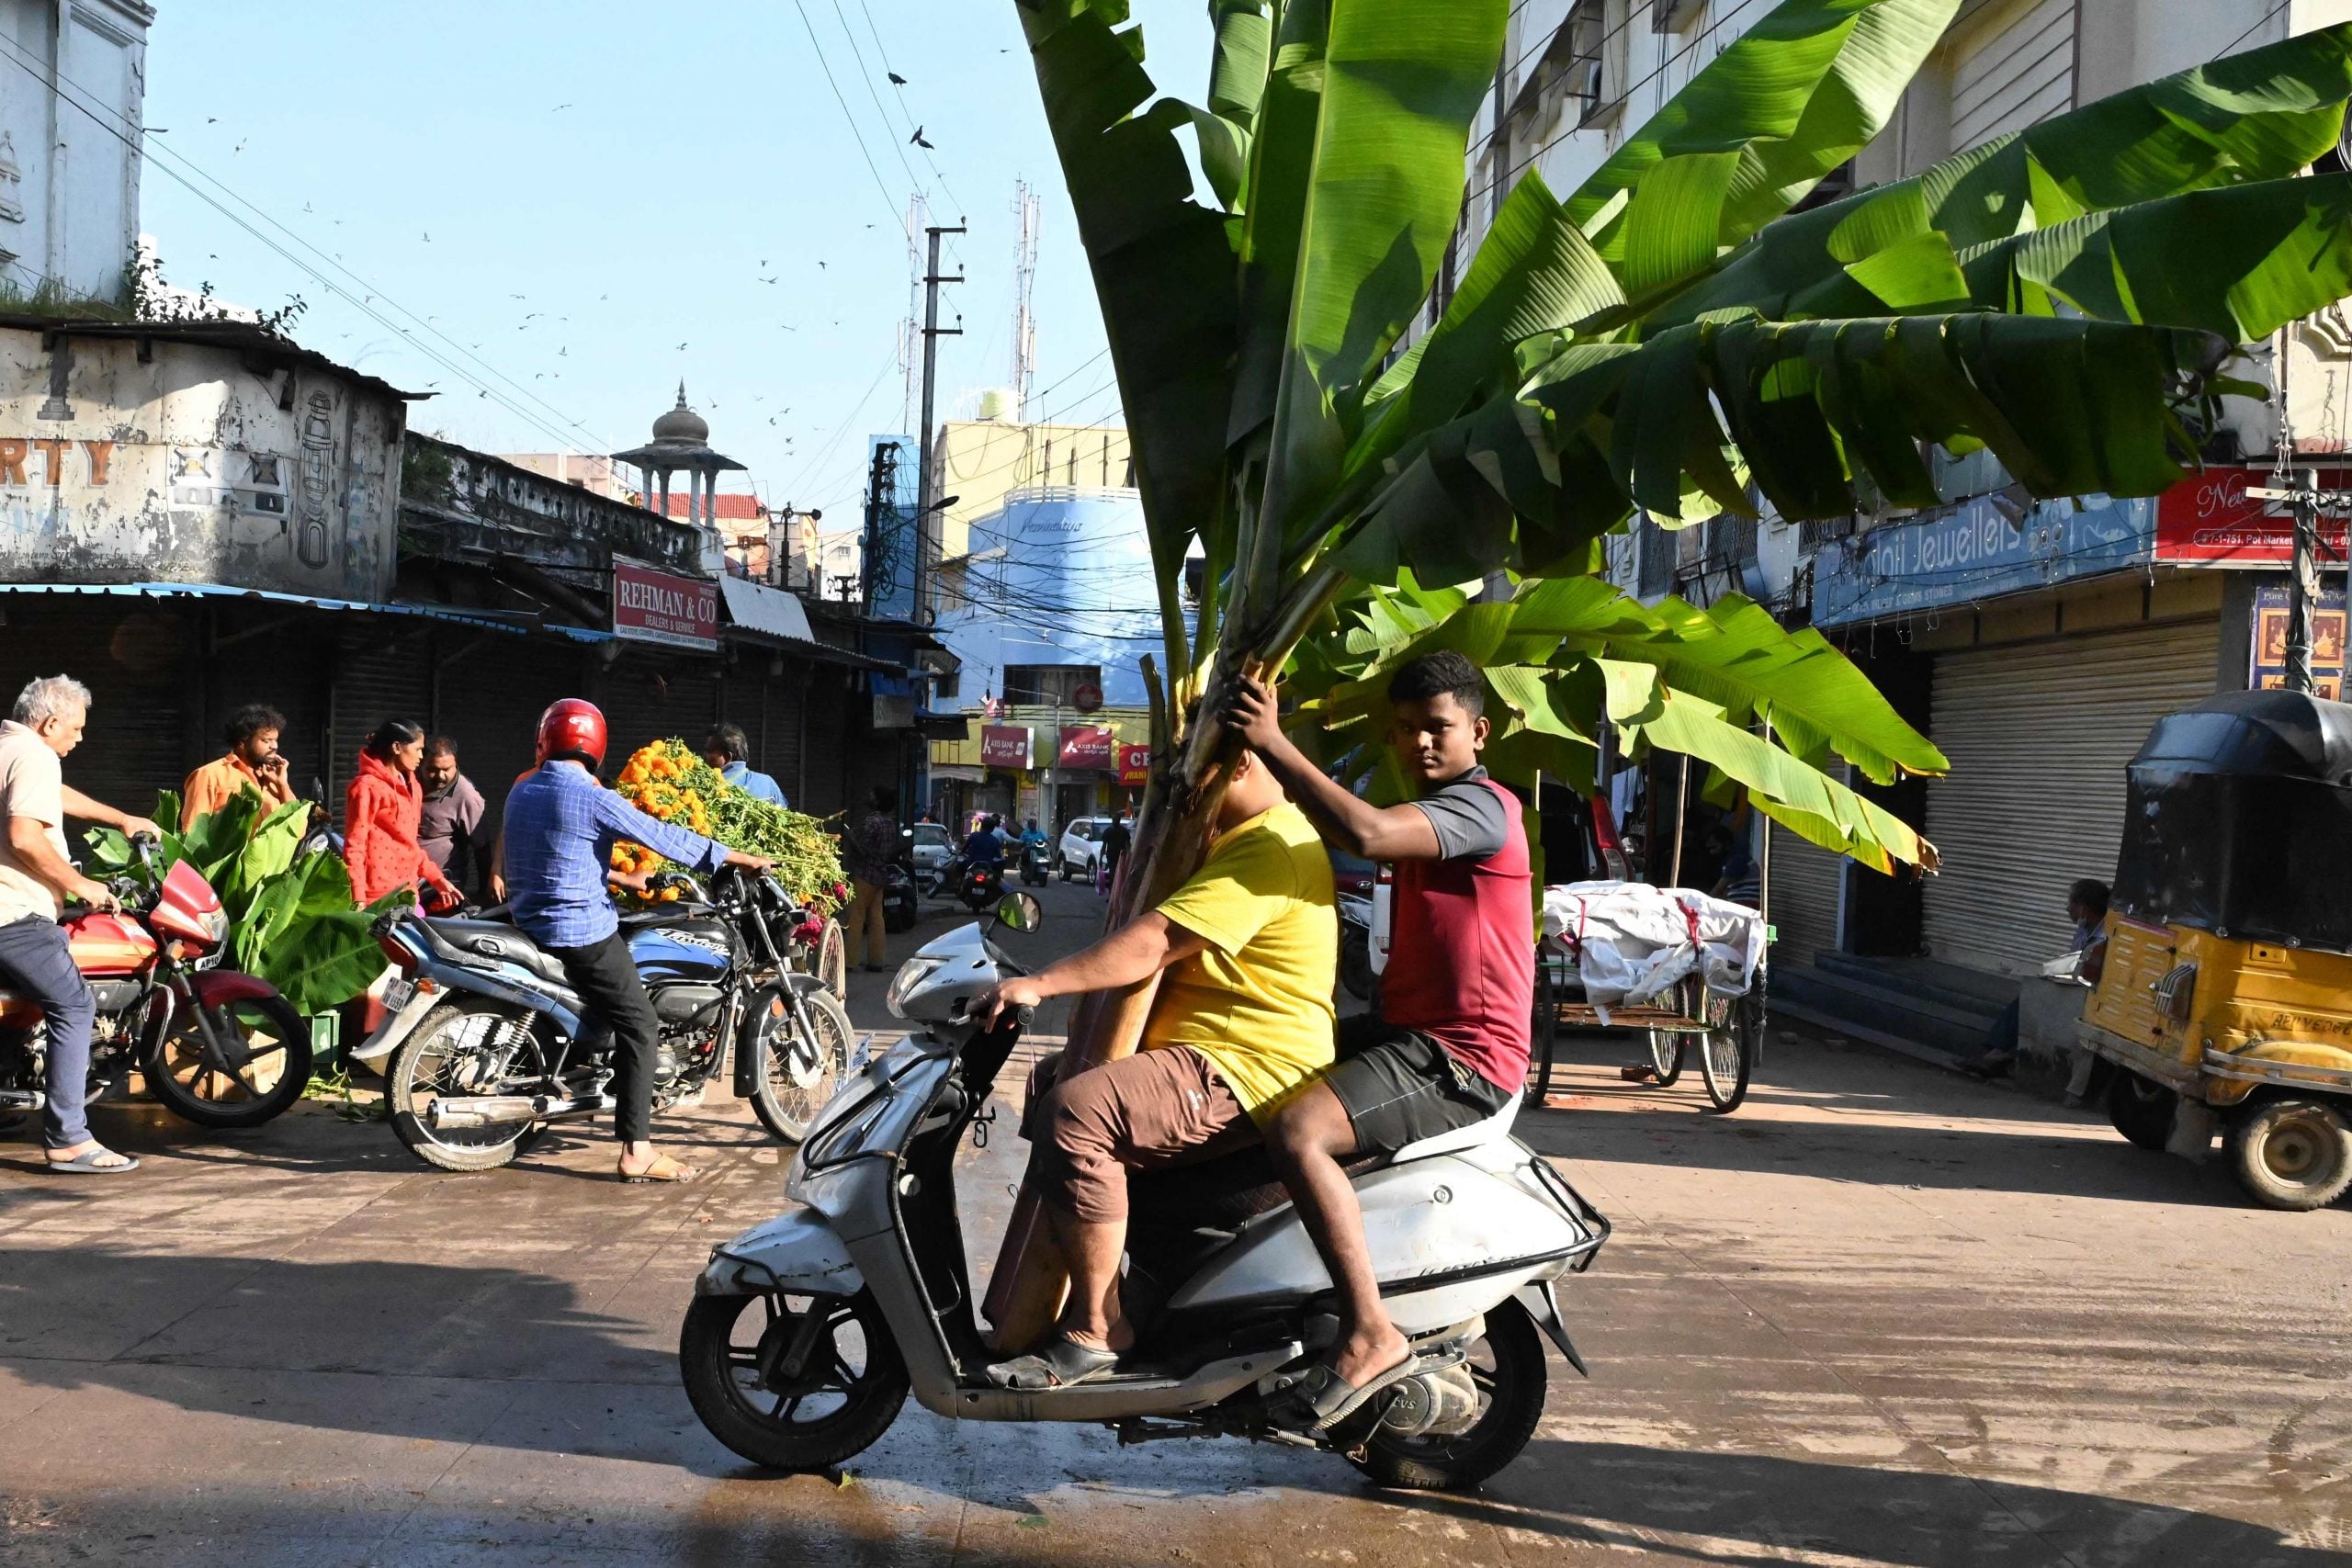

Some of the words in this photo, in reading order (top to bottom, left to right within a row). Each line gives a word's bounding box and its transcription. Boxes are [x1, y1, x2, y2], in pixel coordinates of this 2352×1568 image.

[619, 580, 684, 617] REHMAN
[686, 596, 695, 620] &
[698, 597, 716, 624] CO
[645, 614, 669, 629] DEALERS
[674, 621, 695, 634] SERVICE
[1001, 739, 1014, 749] BANK
